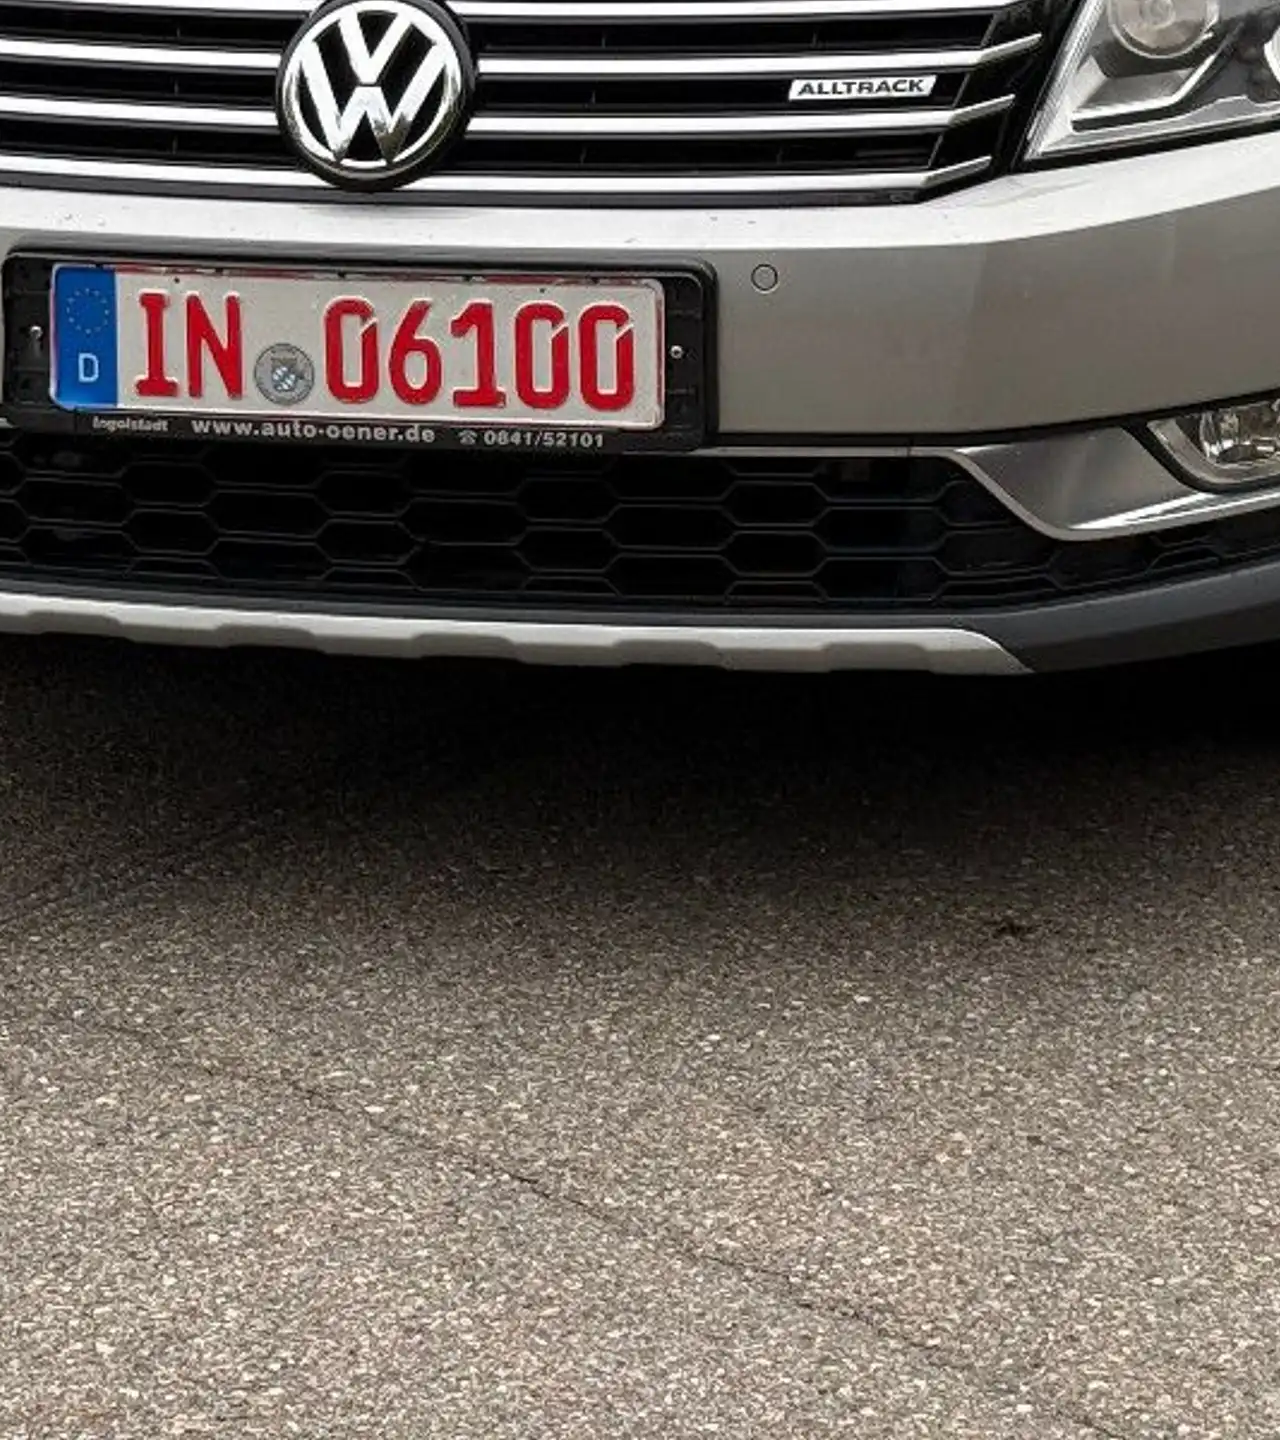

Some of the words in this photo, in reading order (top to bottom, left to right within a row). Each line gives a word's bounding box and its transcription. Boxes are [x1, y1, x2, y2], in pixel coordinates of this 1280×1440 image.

[283, 0, 461, 169] VW
[797, 78, 925, 97] ALLTRACK
[78, 352, 100, 383] D
[135, 291, 243, 399] IN
[324, 297, 636, 410] 06100
[92, 415, 169, 433] Ingolstadt
[190, 419, 436, 442] www.auto-oener.de
[483, 429, 605, 449] 0841/52101
